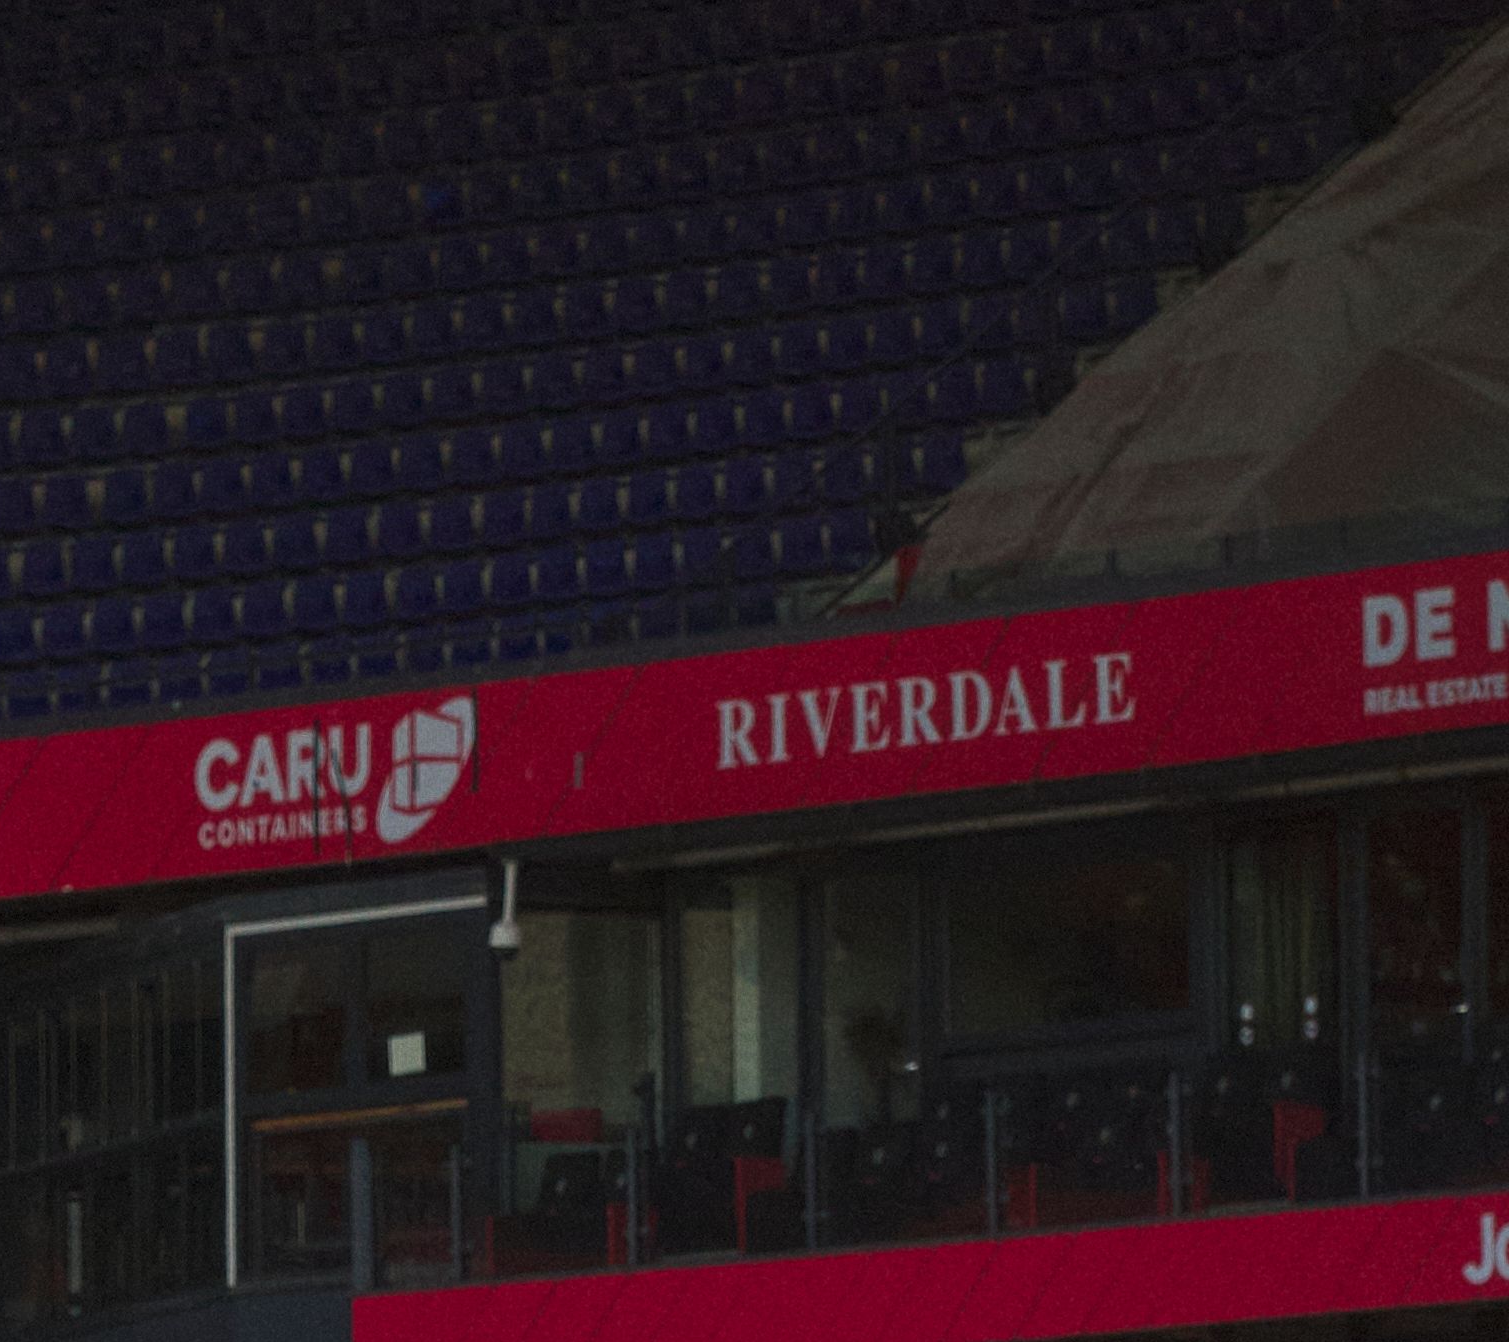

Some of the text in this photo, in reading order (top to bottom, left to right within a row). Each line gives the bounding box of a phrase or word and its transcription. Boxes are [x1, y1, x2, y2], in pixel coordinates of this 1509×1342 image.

[1361, 587, 1455, 667] DE
[714, 652, 1137, 770] RIVERDALE
[1363, 683, 1423, 716] REAL
[1425, 675, 1508, 707] ESTATE
[193, 723, 373, 811] CARU
[197, 804, 367, 851] CONTAINERS
